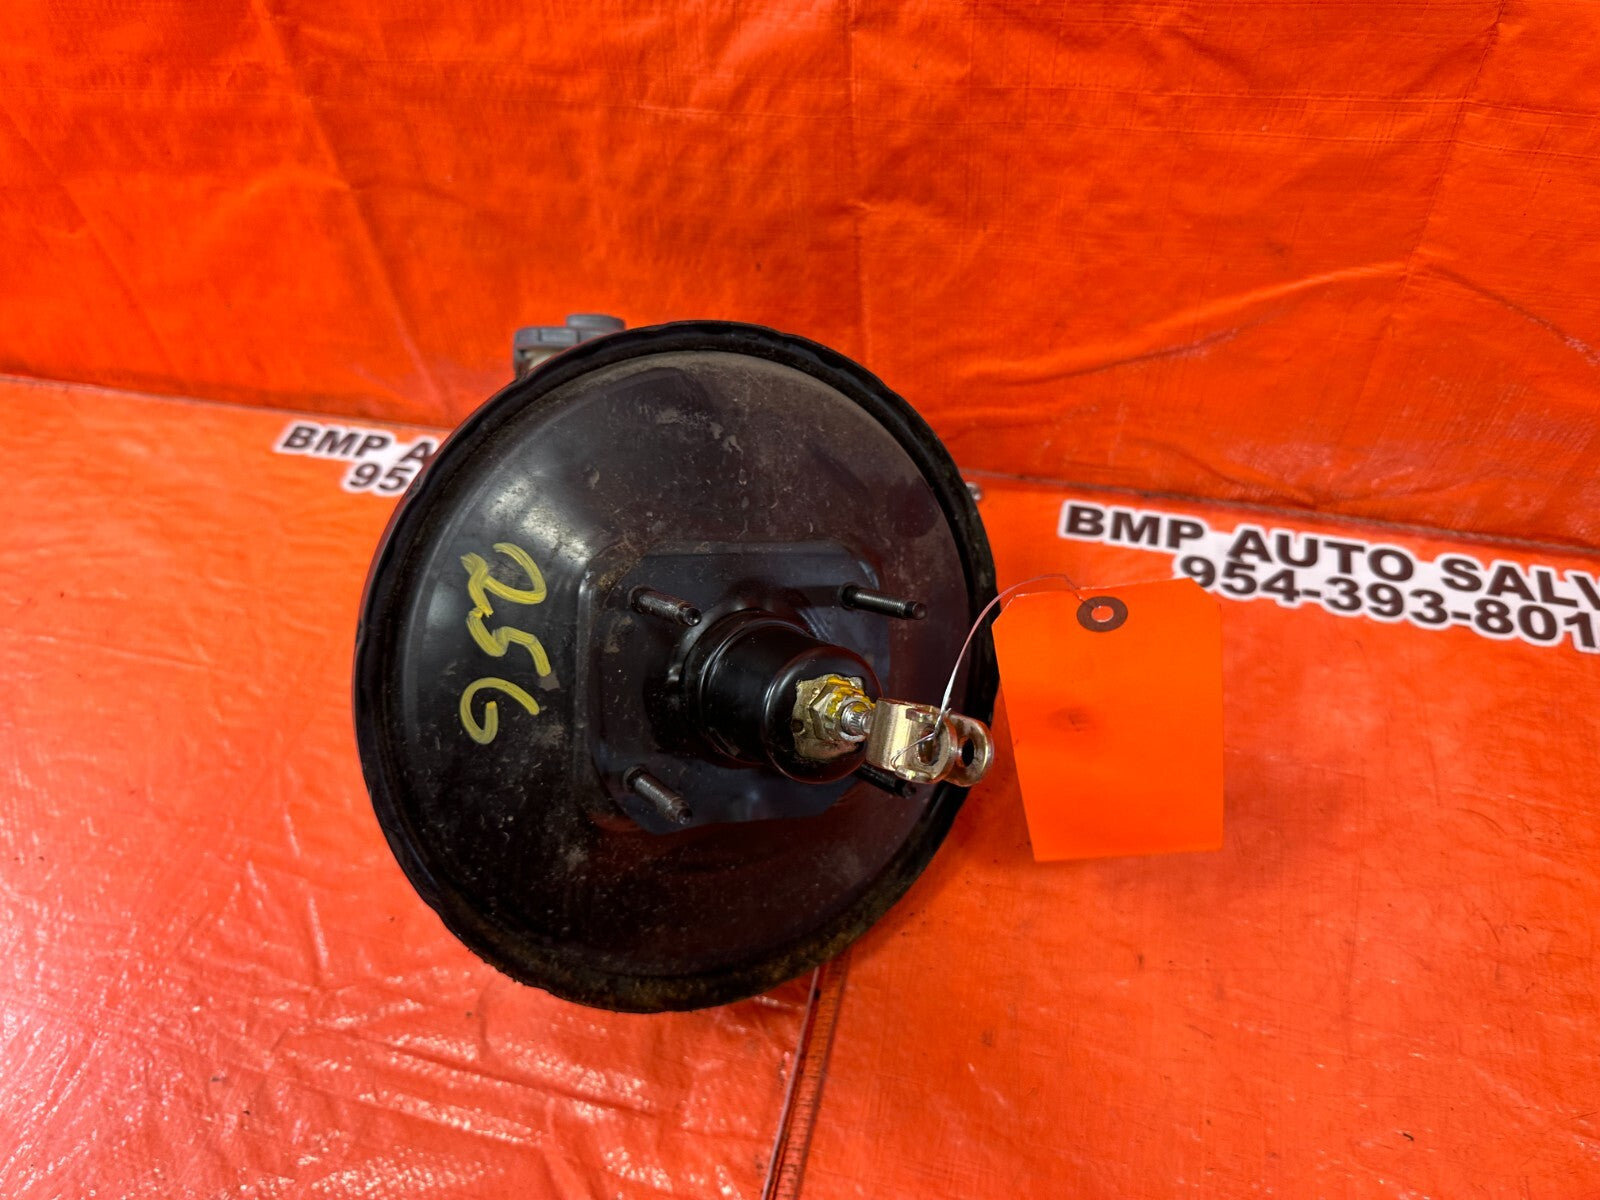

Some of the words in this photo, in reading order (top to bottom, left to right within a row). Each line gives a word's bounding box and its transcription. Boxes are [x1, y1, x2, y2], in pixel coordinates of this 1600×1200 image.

[282, 425, 391, 458] BMP
[1065, 504, 1205, 550] BMP
[1227, 529, 1415, 583] AUTO
[459, 542, 552, 745] 256
